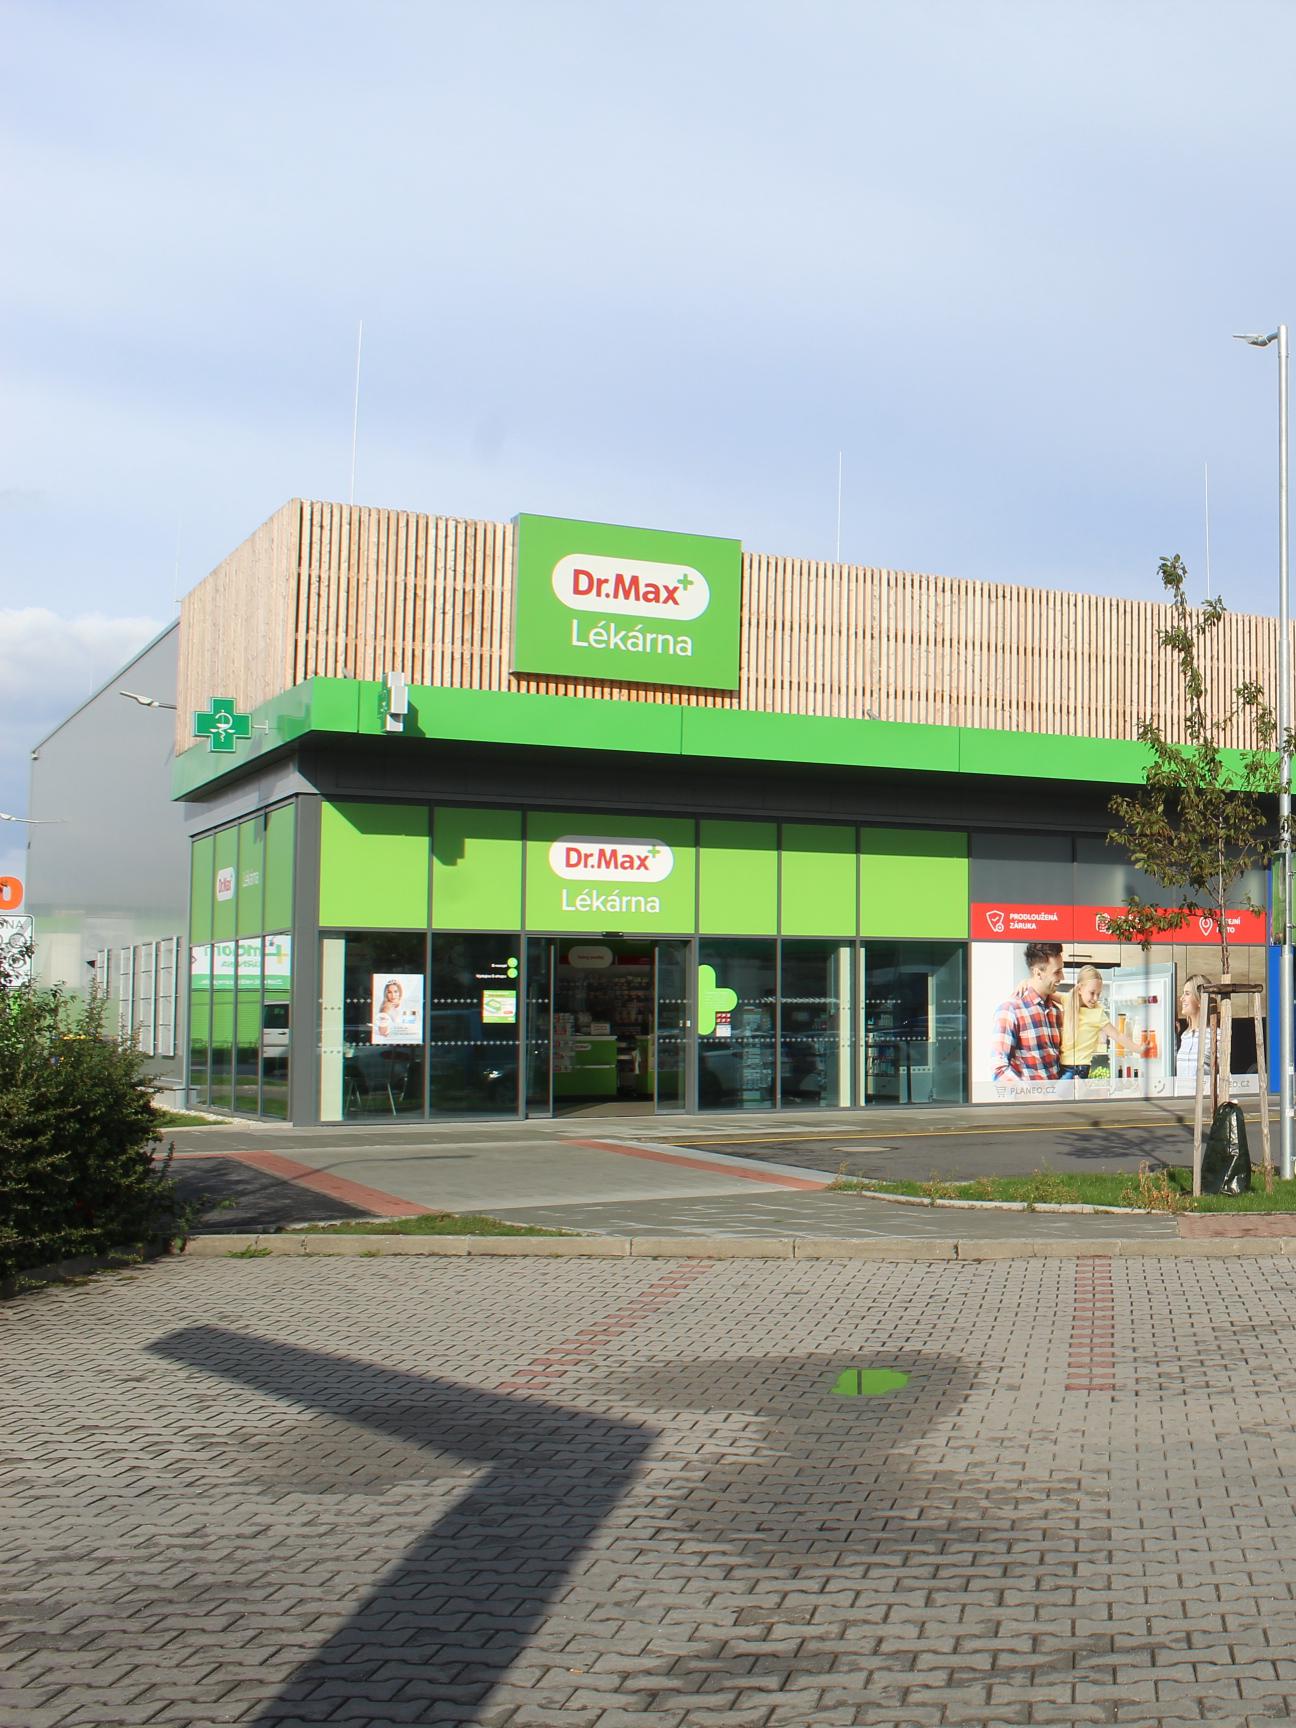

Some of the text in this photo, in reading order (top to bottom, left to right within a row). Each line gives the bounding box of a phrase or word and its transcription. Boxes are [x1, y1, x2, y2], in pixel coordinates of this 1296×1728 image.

[572, 618, 693, 657] Lékárna
[561, 888, 661, 913] Lékárna
[1009, 912, 1059, 921] PRODLOUŽENÁ
[1009, 922, 1037, 930] ZÁRUKA
[1010, 1085, 1057, 1096] PLANEO.CZ
